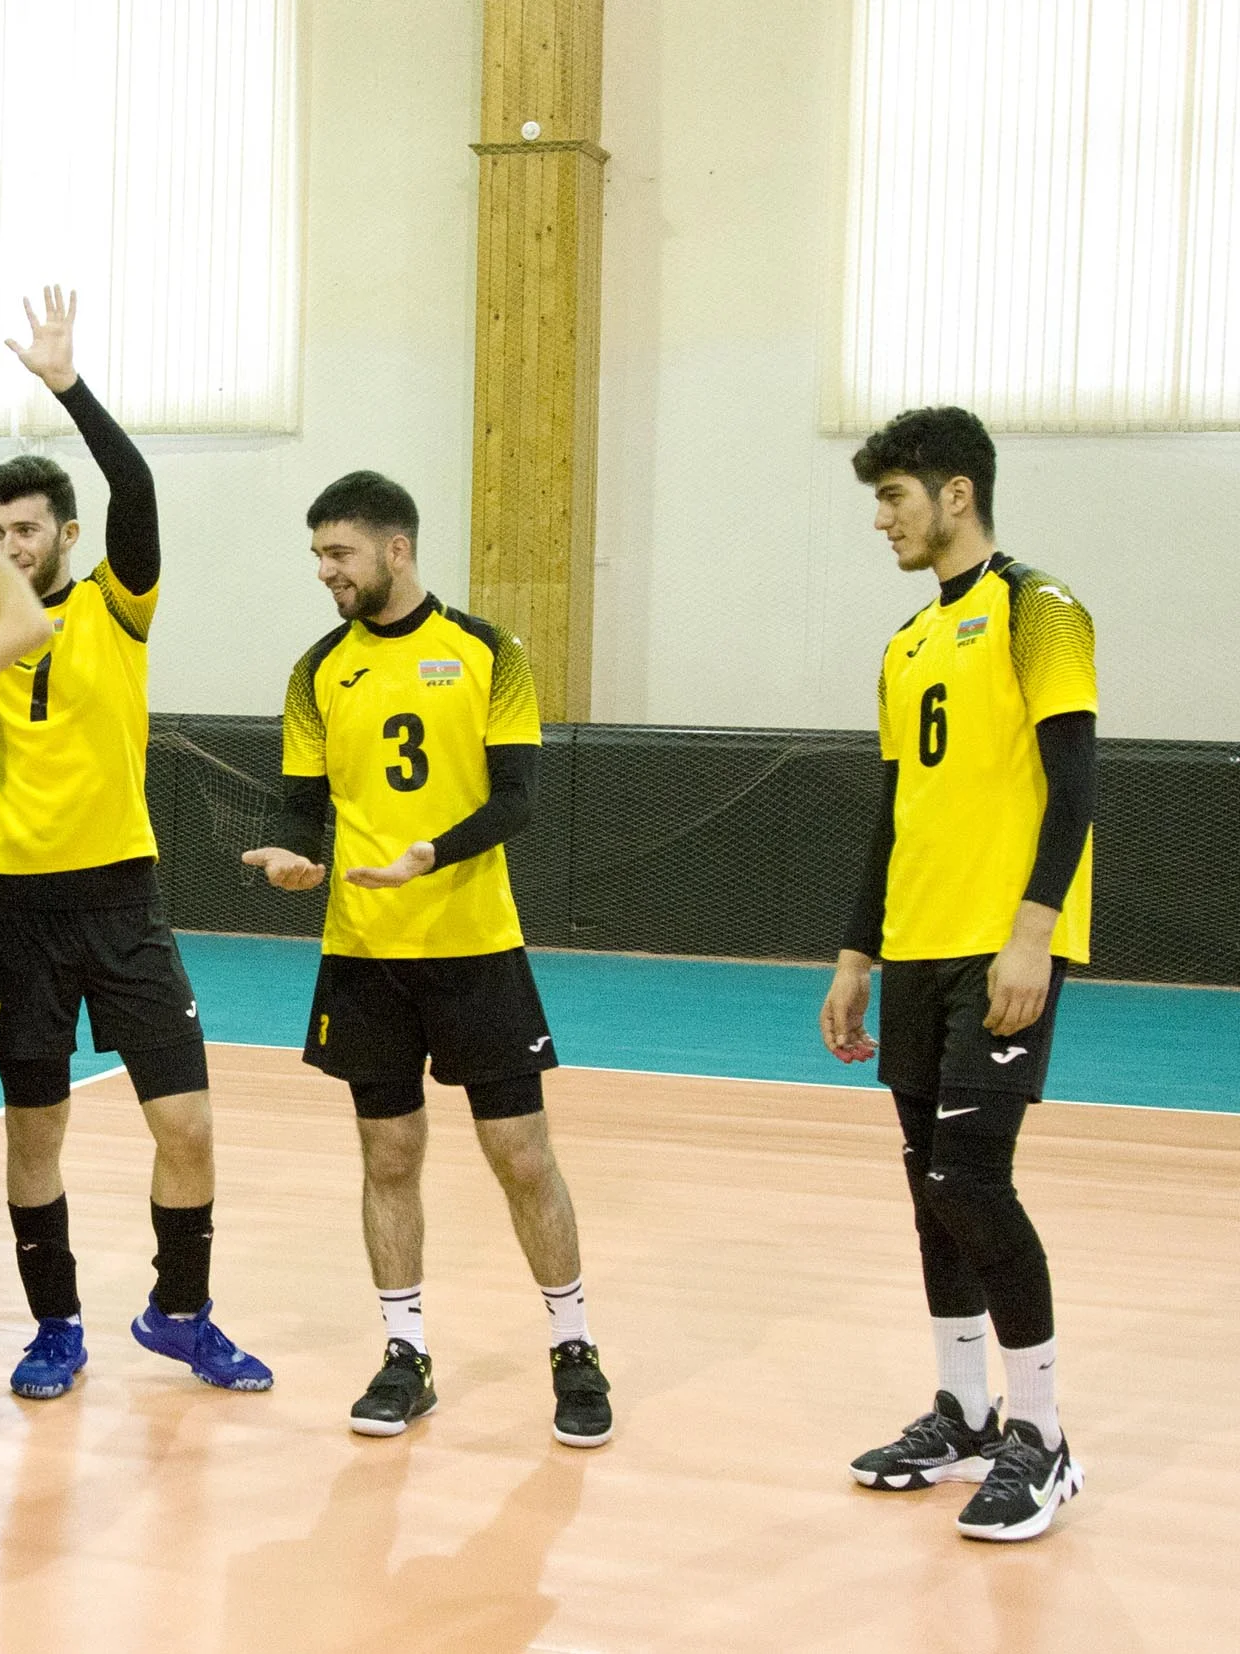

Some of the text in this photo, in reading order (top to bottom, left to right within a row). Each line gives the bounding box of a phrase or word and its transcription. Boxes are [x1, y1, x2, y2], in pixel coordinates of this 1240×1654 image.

[383, 712, 429, 792] 3
[919, 683, 947, 768] 6
[319, 1014, 329, 1046] 3
